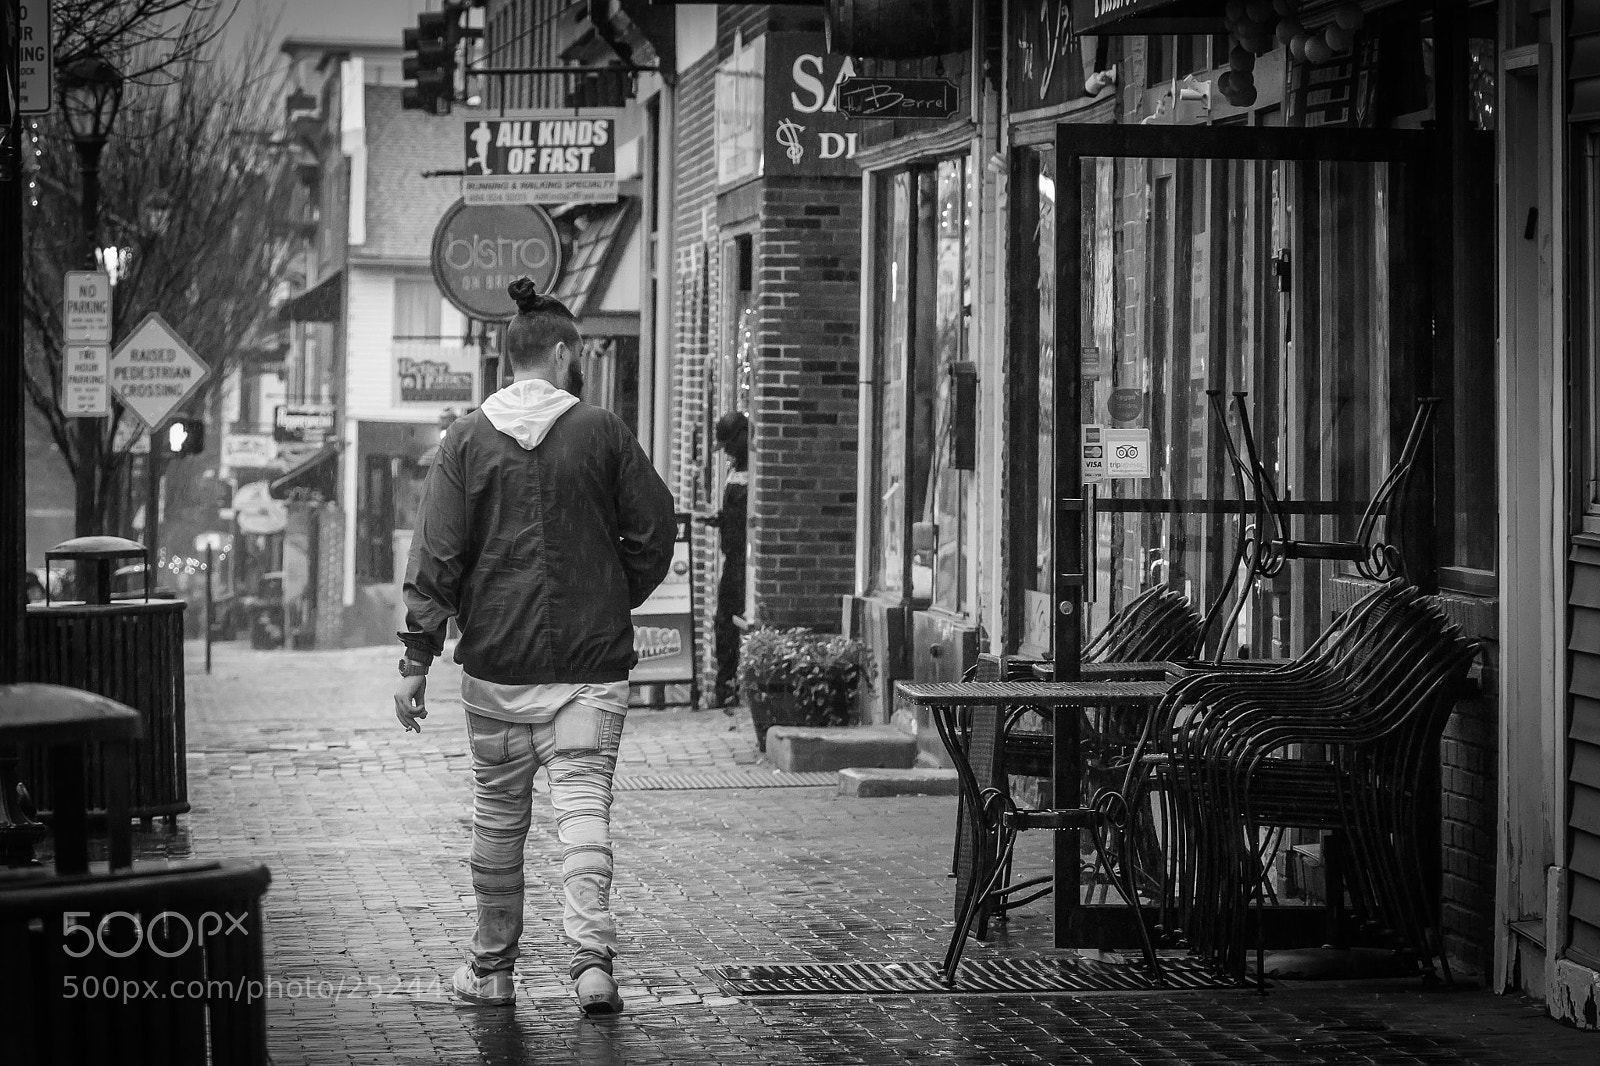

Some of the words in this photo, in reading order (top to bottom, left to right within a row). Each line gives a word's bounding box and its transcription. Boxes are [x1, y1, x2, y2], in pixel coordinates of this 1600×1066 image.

[20, 46, 45, 62] ING
[791, 54, 857, 114] SA
[862, 84, 948, 114] Barrel
[496, 121, 534, 147] ALL
[538, 119, 609, 146] KINDS
[818, 132, 858, 159] DI
[507, 147, 537, 174] OF
[539, 146, 595, 173] FAST
[445, 233, 550, 270] bistro
[78, 284, 97, 298] NO
[68, 300, 107, 314] PARKING
[130, 348, 177, 363] RAISED
[114, 366, 192, 381] PEDESTRIAN
[120, 383, 184, 398] CROSSING
